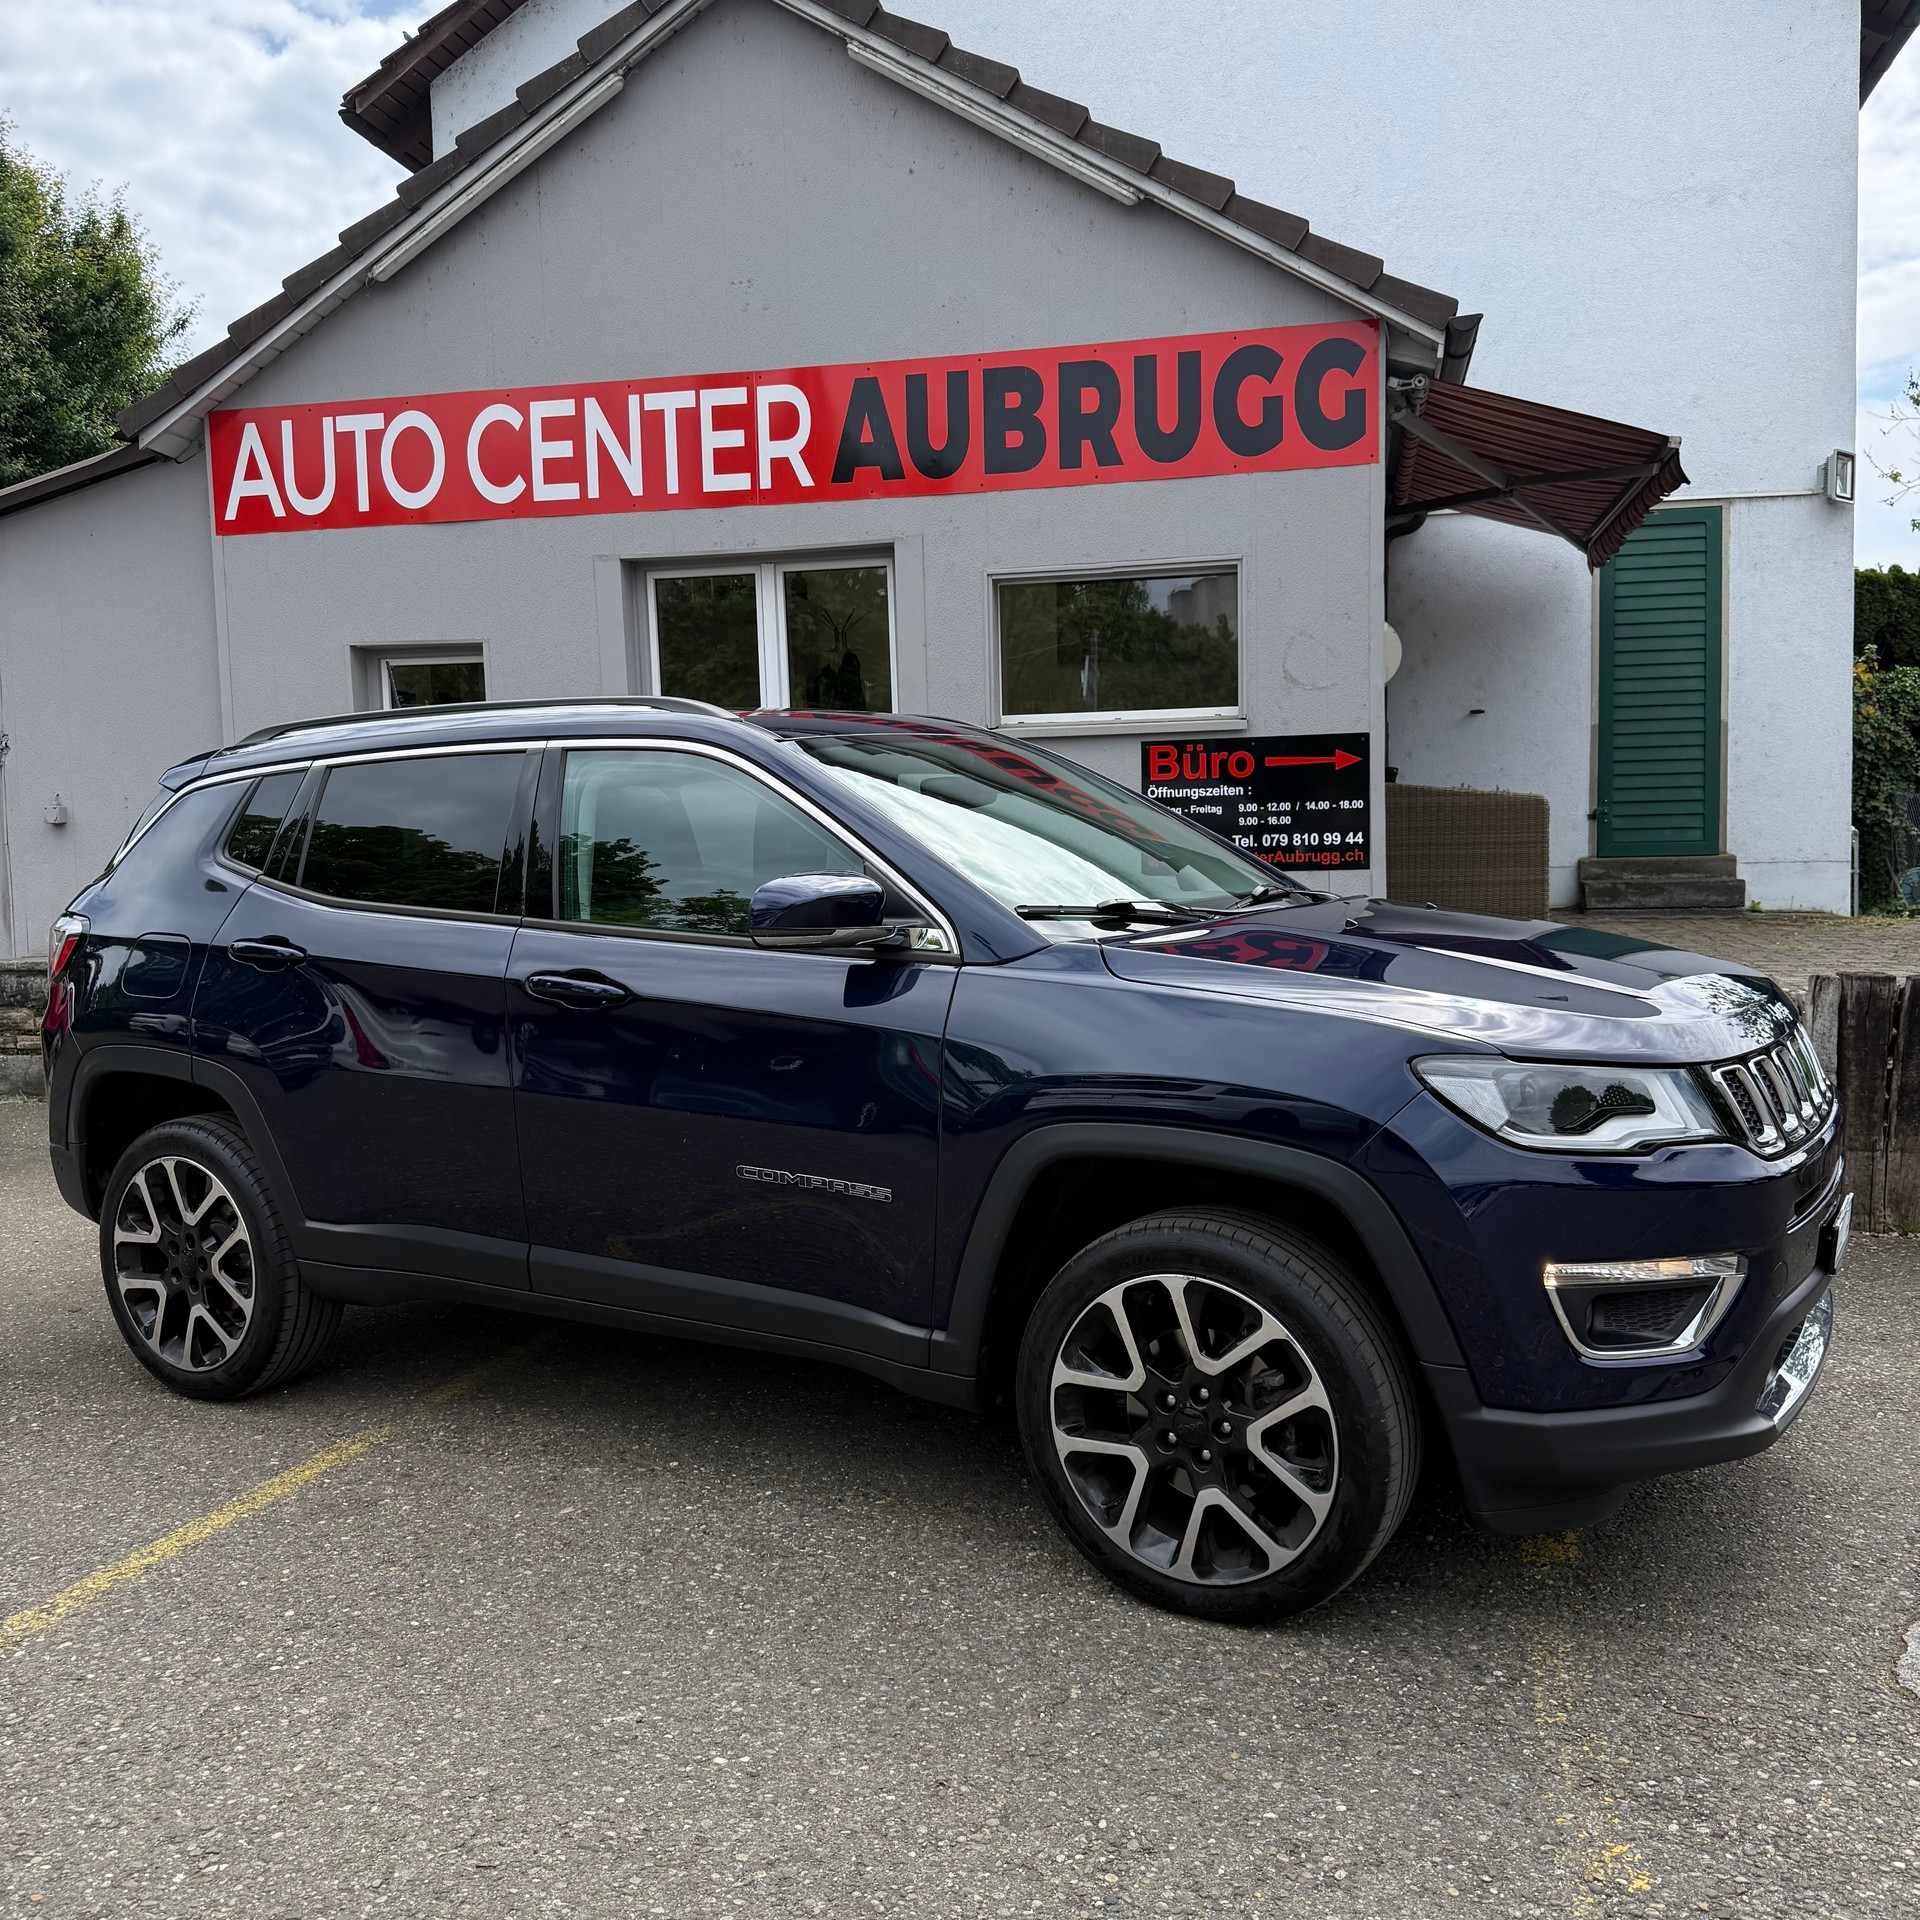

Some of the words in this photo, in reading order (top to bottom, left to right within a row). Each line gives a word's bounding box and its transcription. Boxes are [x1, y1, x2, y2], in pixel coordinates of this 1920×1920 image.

[224, 410, 446, 521] AUTO
[467, 384, 815, 504] CENTER
[831, 337, 1367, 484] AUBRUGG
[1150, 744, 1255, 781] Büro
[1147, 784, 1244, 799] Öffnungszeiten
[1190, 804, 1223, 815] Freitag
[1238, 803, 1258, 812] 9.00
[1266, 802, 1291, 812] 12.00
[1305, 800, 1330, 810] 14.00
[1339, 799, 1364, 809] 18.00
[1238, 816, 1258, 825] 9.00
[1267, 815, 1292, 825] 16.00
[1232, 834, 1258, 847] Tel.
[1262, 833, 1288, 847] 079
[1292, 833, 1319, 846] 810
[1323, 832, 1341, 845] 99
[1345, 831, 1364, 844] 44
[735, 1165, 892, 1203] COMPASS
